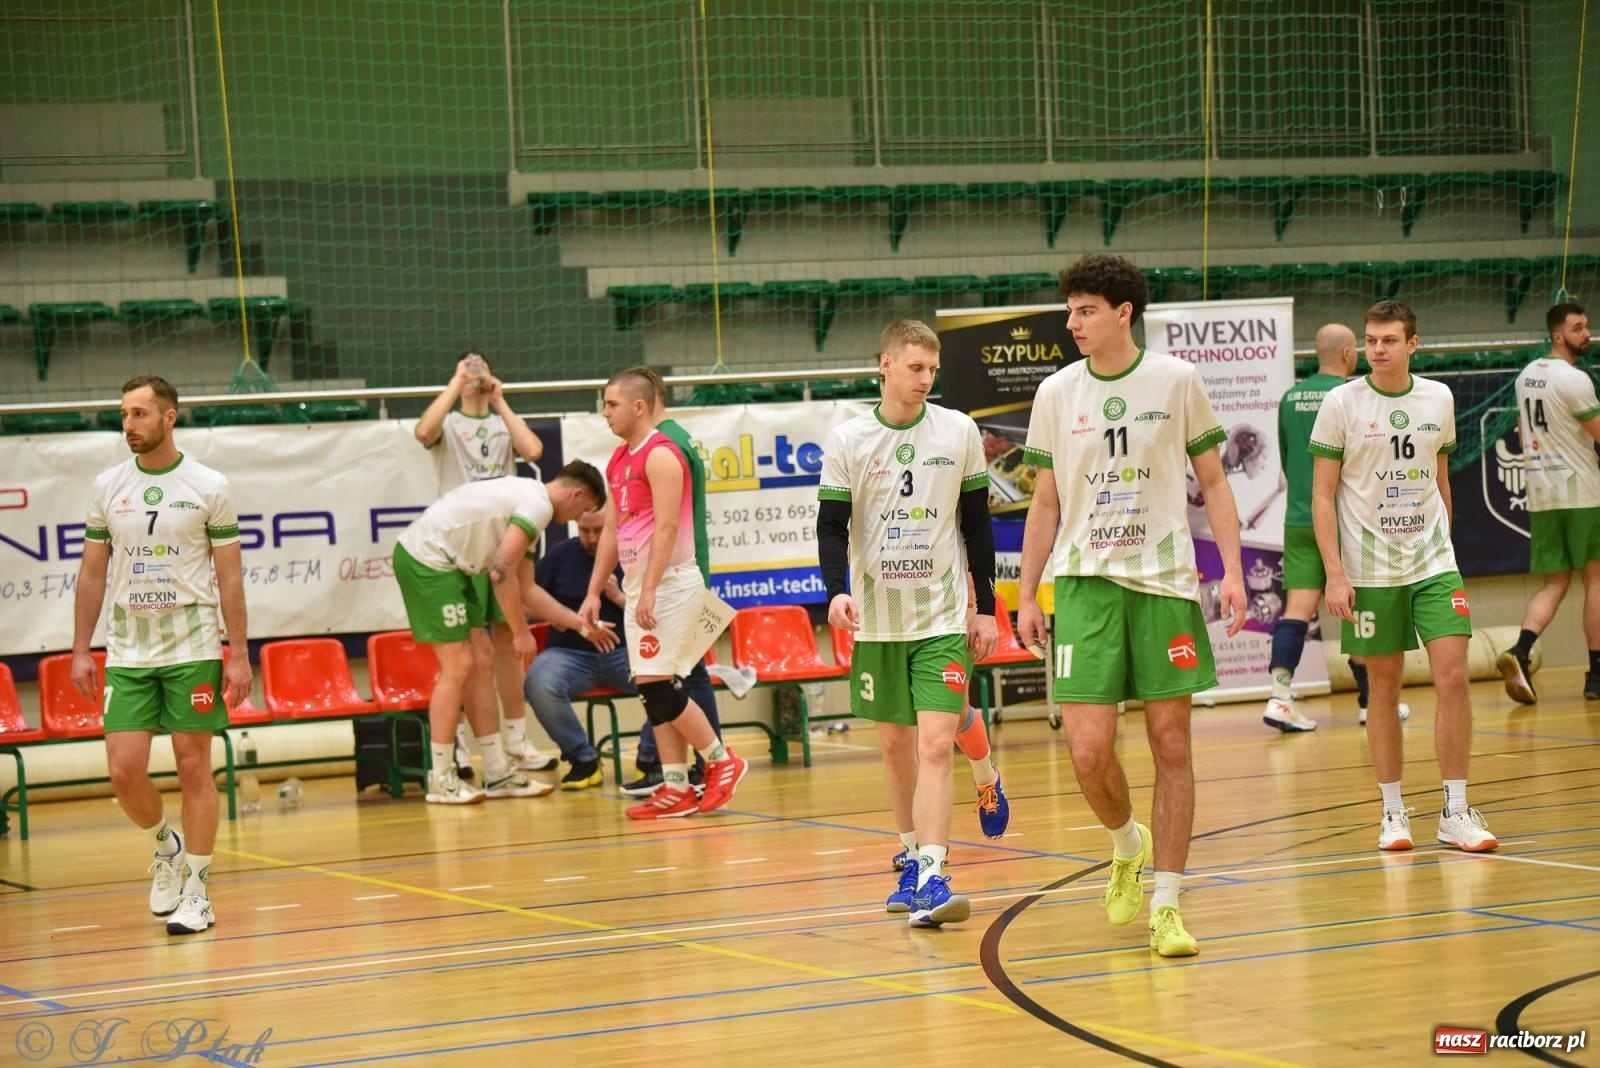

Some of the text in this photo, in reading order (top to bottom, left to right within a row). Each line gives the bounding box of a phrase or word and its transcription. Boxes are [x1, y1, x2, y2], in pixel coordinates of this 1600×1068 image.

[1166, 318, 1277, 346] PIVEXIN
[981, 343, 1064, 363] SZYPUŁA
[1168, 345, 1277, 363] TECHNOLOGY
[1236, 373, 1267, 385] tempa
[1525, 397, 1549, 433] 14
[481, 442, 489, 457] 6
[1103, 426, 1128, 459] 11
[1390, 434, 1416, 460] 16
[900, 469, 914, 497] 3
[1085, 467, 1150, 485] VISON
[1375, 468, 1430, 481] VISON
[145, 510, 159, 536] 7
[723, 510, 750, 525] 502
[755, 507, 783, 522] 632
[787, 504, 816, 520] 695
[880, 507, 938, 521] VISON
[1380, 514, 1425, 527] PIVEXIN
[733, 532, 750, 547] ul.
[769, 530, 798, 544] von
[1090, 523, 1146, 541] PIVEXIN
[1381, 525, 1425, 535] TECHNOLOGY
[124, 544, 180, 557] VISON
[1090, 537, 1146, 550] TECHNOLOGY
[286, 559, 321, 585] FM
[881, 559, 934, 572] PIVEXIN
[882, 571, 933, 580] TECHNOLOGY
[129, 591, 177, 603] PIVEXIN
[129, 602, 177, 611] TECHNOLOGY
[1353, 610, 1376, 639] 16
[1056, 643, 1074, 679] 11
[860, 671, 875, 701] 3
